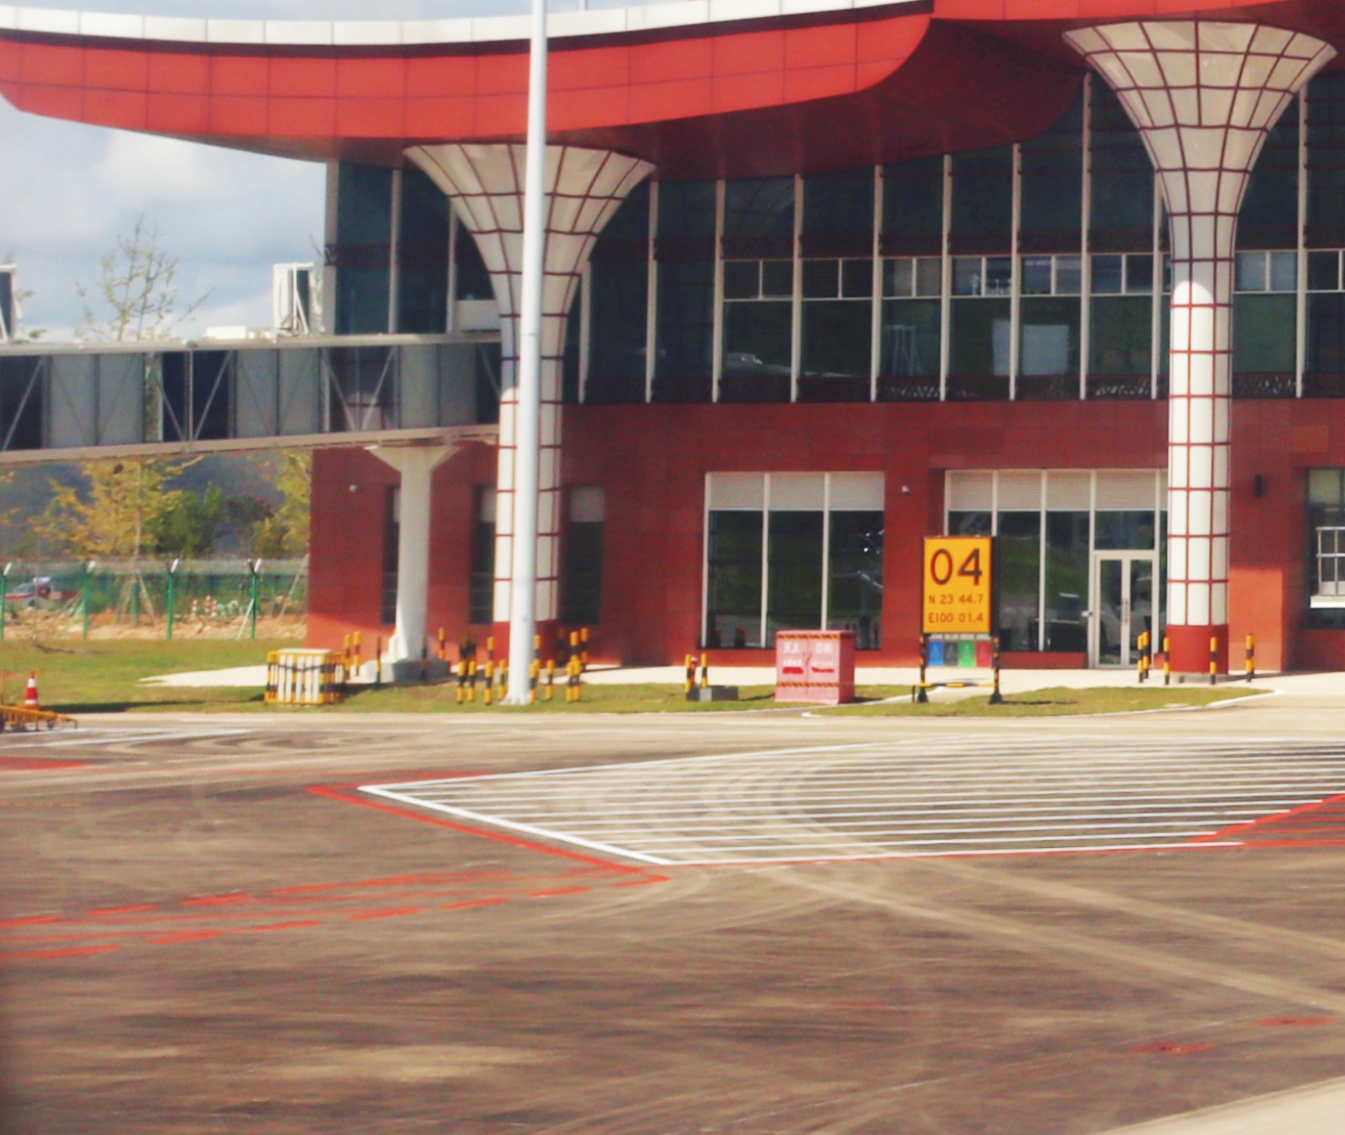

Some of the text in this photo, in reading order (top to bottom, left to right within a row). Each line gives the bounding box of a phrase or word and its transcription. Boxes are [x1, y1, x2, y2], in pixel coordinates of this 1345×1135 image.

[930, 548, 983, 586] 04
[928, 593, 984, 605] N 23 44.7
[928, 612, 984, 624] E100 01.4
